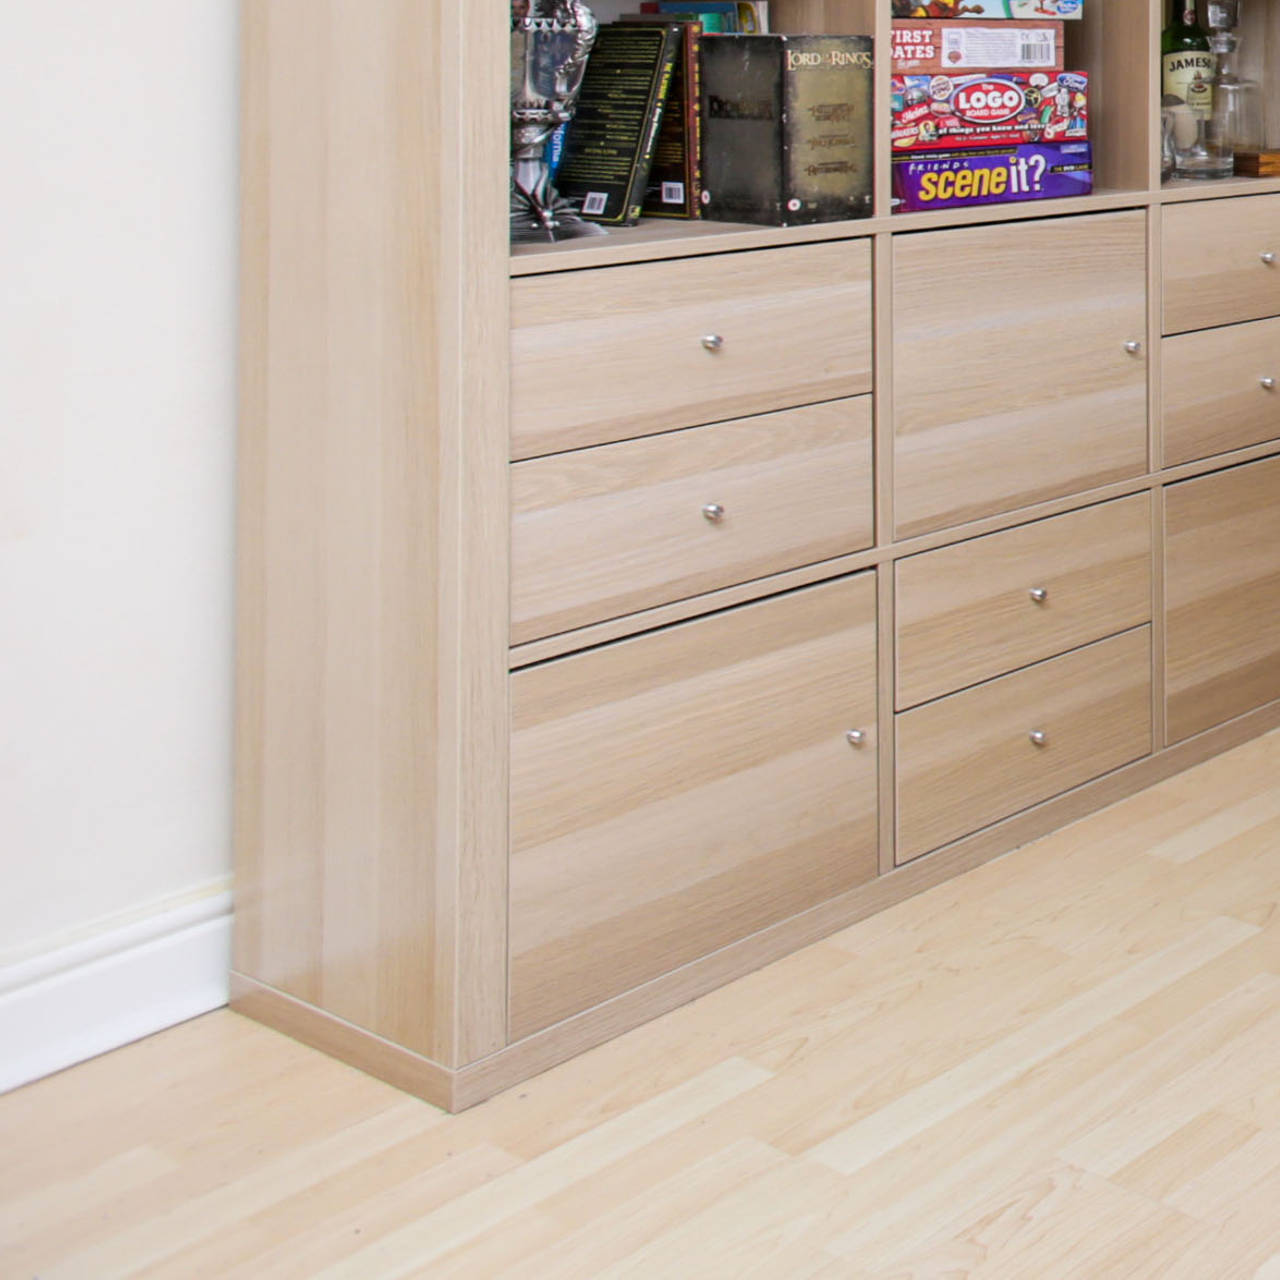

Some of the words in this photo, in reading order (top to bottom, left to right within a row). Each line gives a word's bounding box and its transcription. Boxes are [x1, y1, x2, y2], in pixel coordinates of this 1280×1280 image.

[786, 50, 821, 71] LORD
[831, 50, 872, 69] RINGS
[1169, 57, 1212, 72] JAMES
[959, 89, 1019, 110] LOGO
[918, 167, 1008, 201] scene
[1009, 153, 1047, 193] it?
